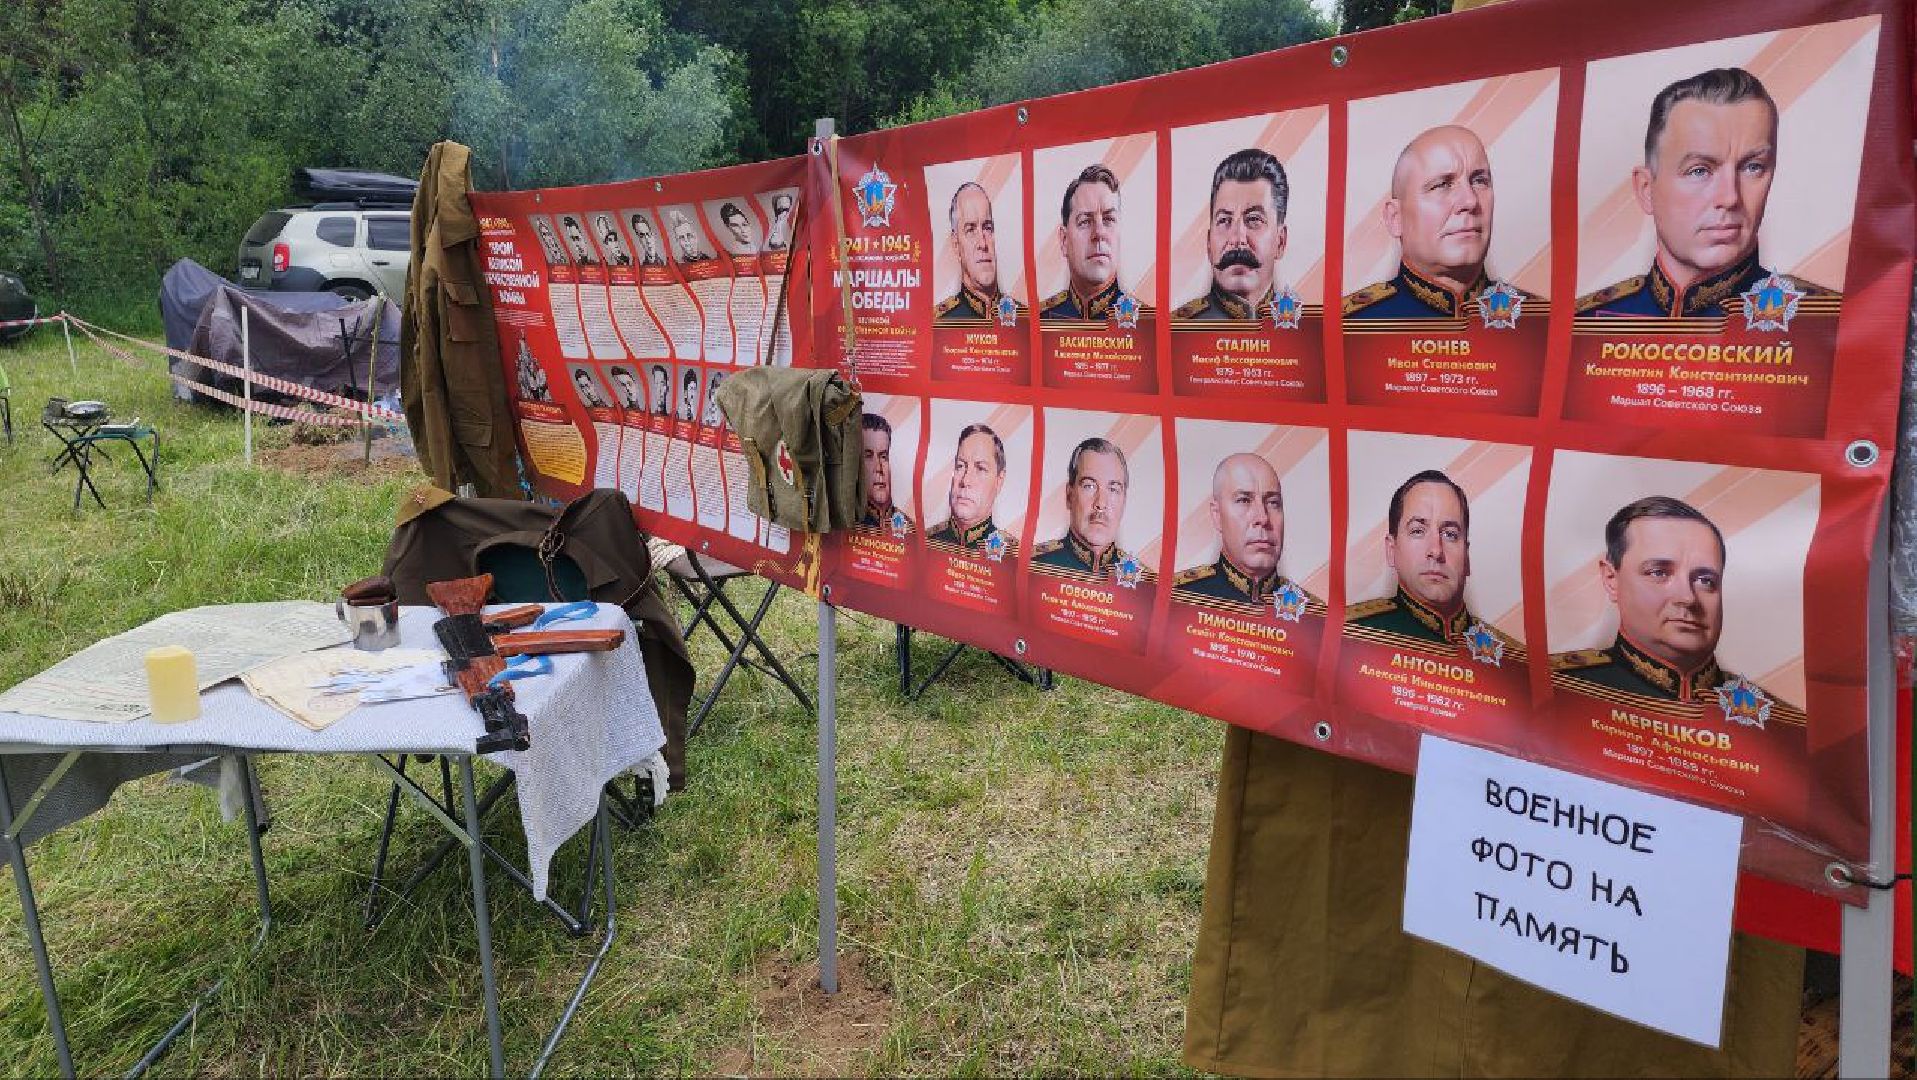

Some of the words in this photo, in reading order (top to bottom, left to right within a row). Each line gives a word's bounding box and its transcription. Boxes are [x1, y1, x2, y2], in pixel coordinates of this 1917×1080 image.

[881, 234, 911, 253] 1945
[1059, 334, 1134, 350] ВАСИЛЕВСКИЙ
[1215, 337, 1271, 353] СТАЛИН
[1410, 338, 1471, 356] КОНЕВ
[1600, 340, 1794, 366] РОКОССОВСКИЙ
[1386, 357, 1419, 369] Иван
[1421, 358, 1498, 372] Степанович
[1585, 361, 1664, 379] Константин
[1668, 364, 1810, 386] Константинович
[1403, 372, 1428, 382] 1897
[1439, 373, 1464, 384] 1973
[1635, 383, 1666, 396] 1896
[1681, 385, 1715, 399] 1968
[1609, 395, 1652, 409] Маршал
[1653, 397, 1719, 413] Советского
[1721, 401, 1763, 415] Союза
[1060, 583, 1114, 604] ГОВОРОВ
[1197, 611, 1288, 642] ТИМОШЕНКО
[1359, 663, 1408, 684] Алексей
[1390, 652, 1476, 684] АНТОНОВ
[1611, 708, 1733, 751] МЕРЕЦКОВ
[1591, 717, 1643, 743] Кирилл
[1650, 737, 1760, 774] Афанасьевич
[1485, 777, 1657, 854] ВОЕННОЕ
[1471, 836, 1574, 891] ФОТО
[1591, 870, 1643, 917] НА
[1474, 891, 1631, 974] ПАМЯТЬ
